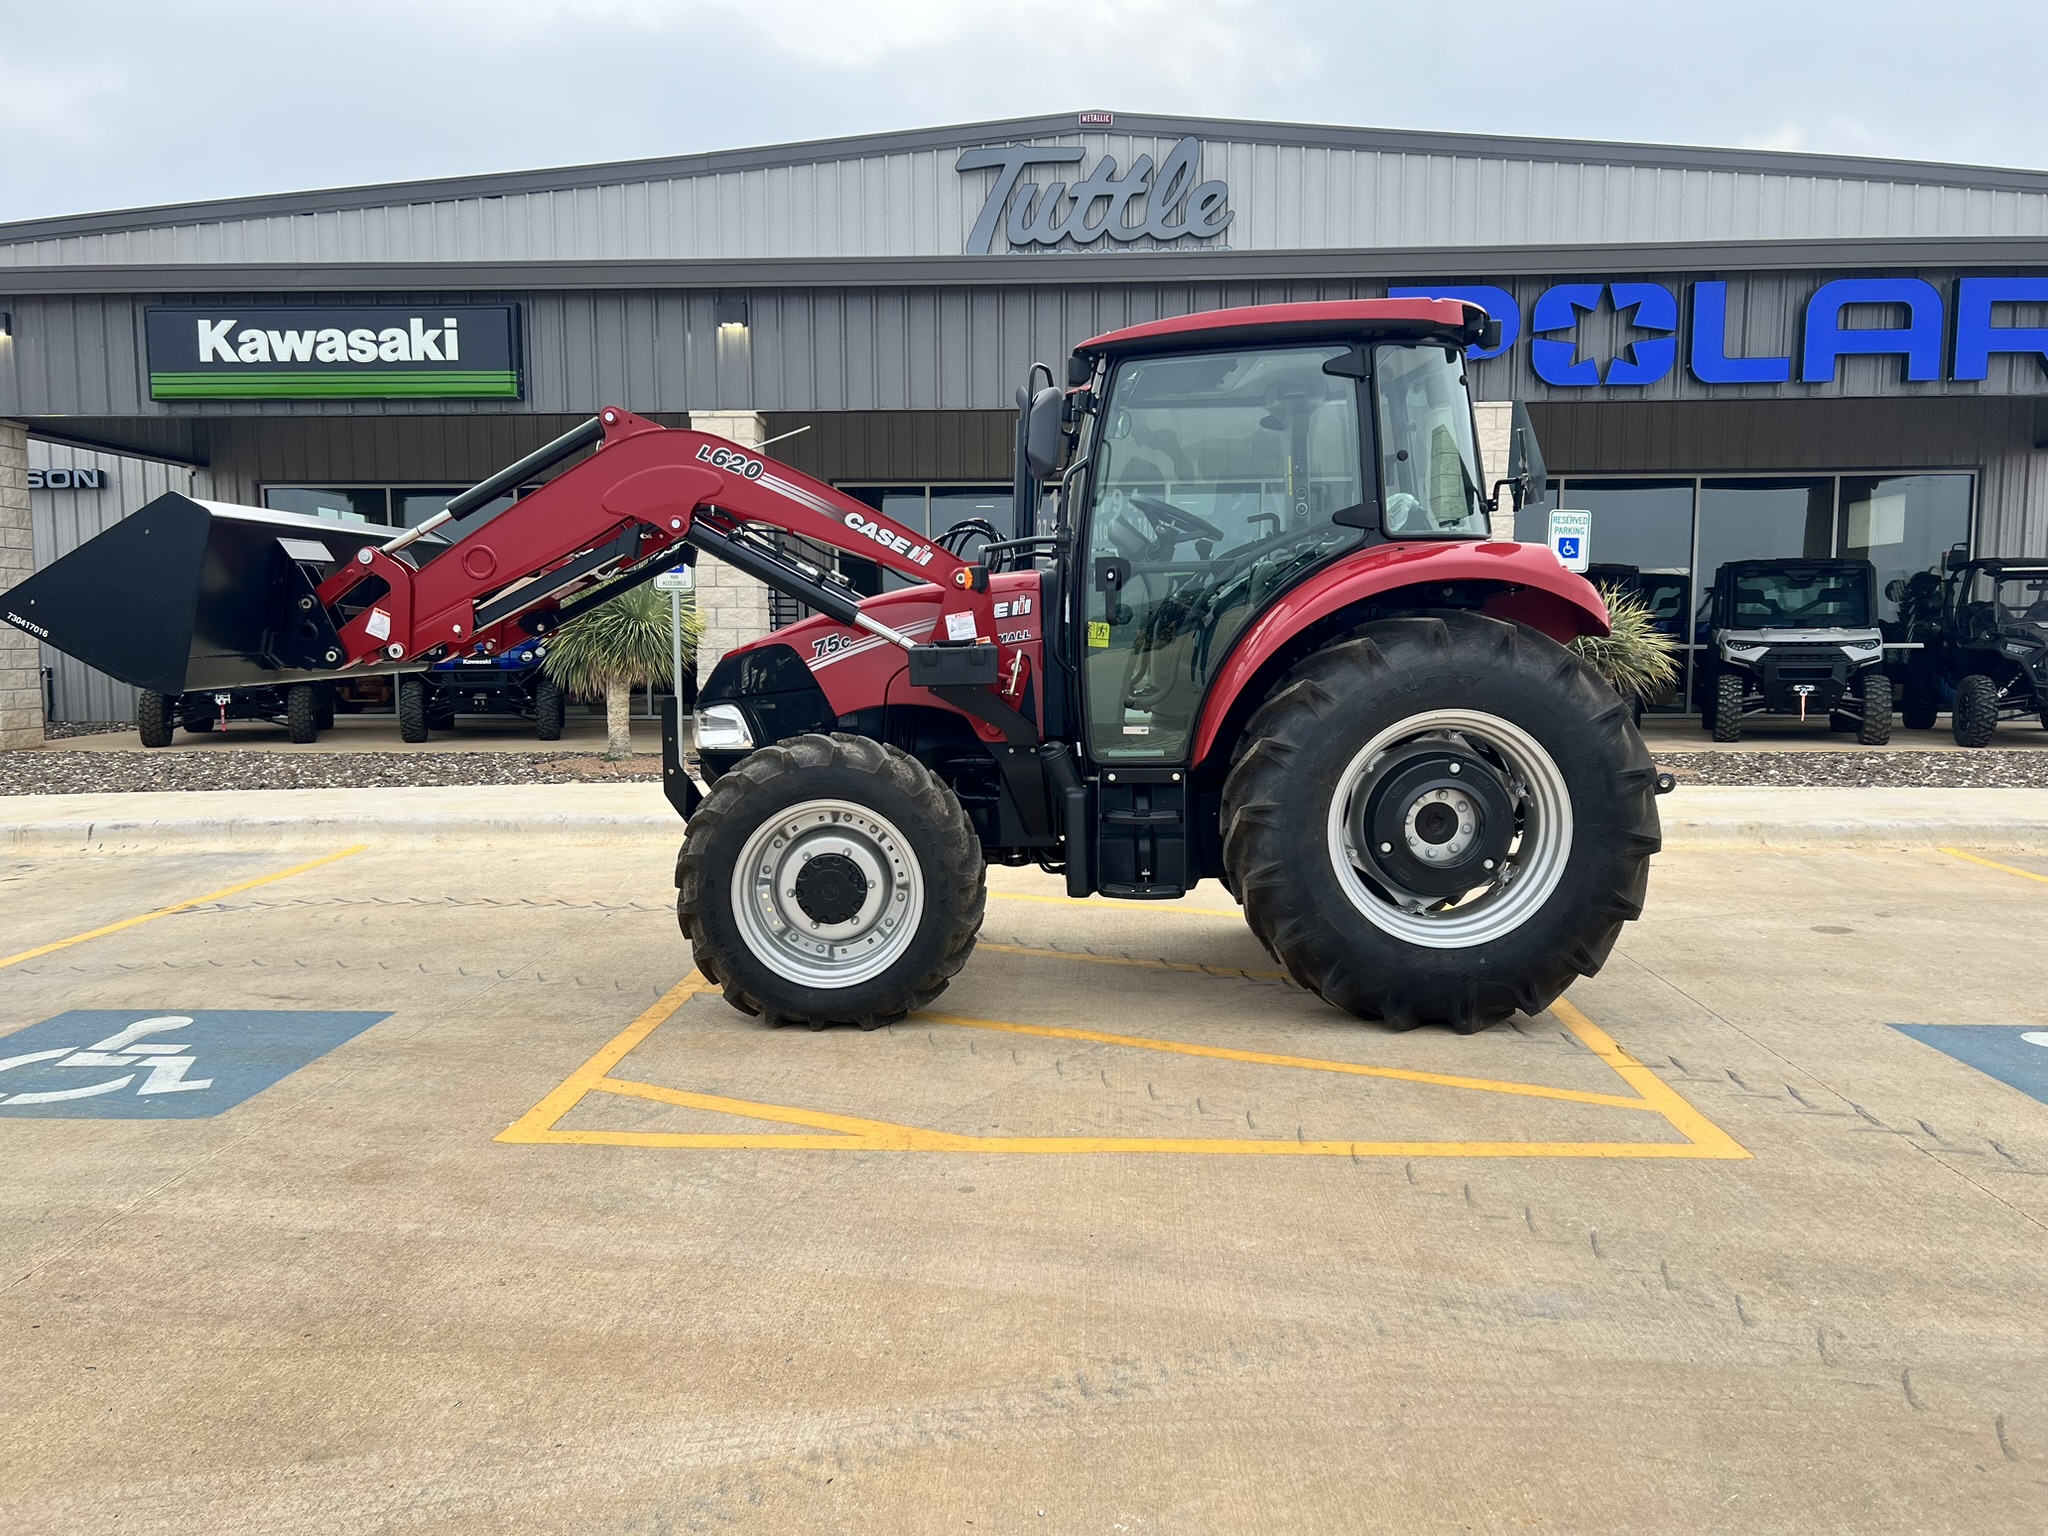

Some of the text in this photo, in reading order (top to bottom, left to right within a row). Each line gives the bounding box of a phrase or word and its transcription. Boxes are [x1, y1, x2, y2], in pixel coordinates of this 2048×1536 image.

[1081, 114, 1110, 123] METALLIC
[955, 136, 1235, 254] Tuttle
[197, 318, 459, 363] Kawasaki
[696, 444, 764, 481] L620
[844, 512, 911, 555] CASE
[1553, 515, 1588, 525] RESERVED
[1554, 526, 1585, 536] PARKING
[7, 611, 49, 638] 730417016
[1366, 674, 1485, 711] GALAXY
